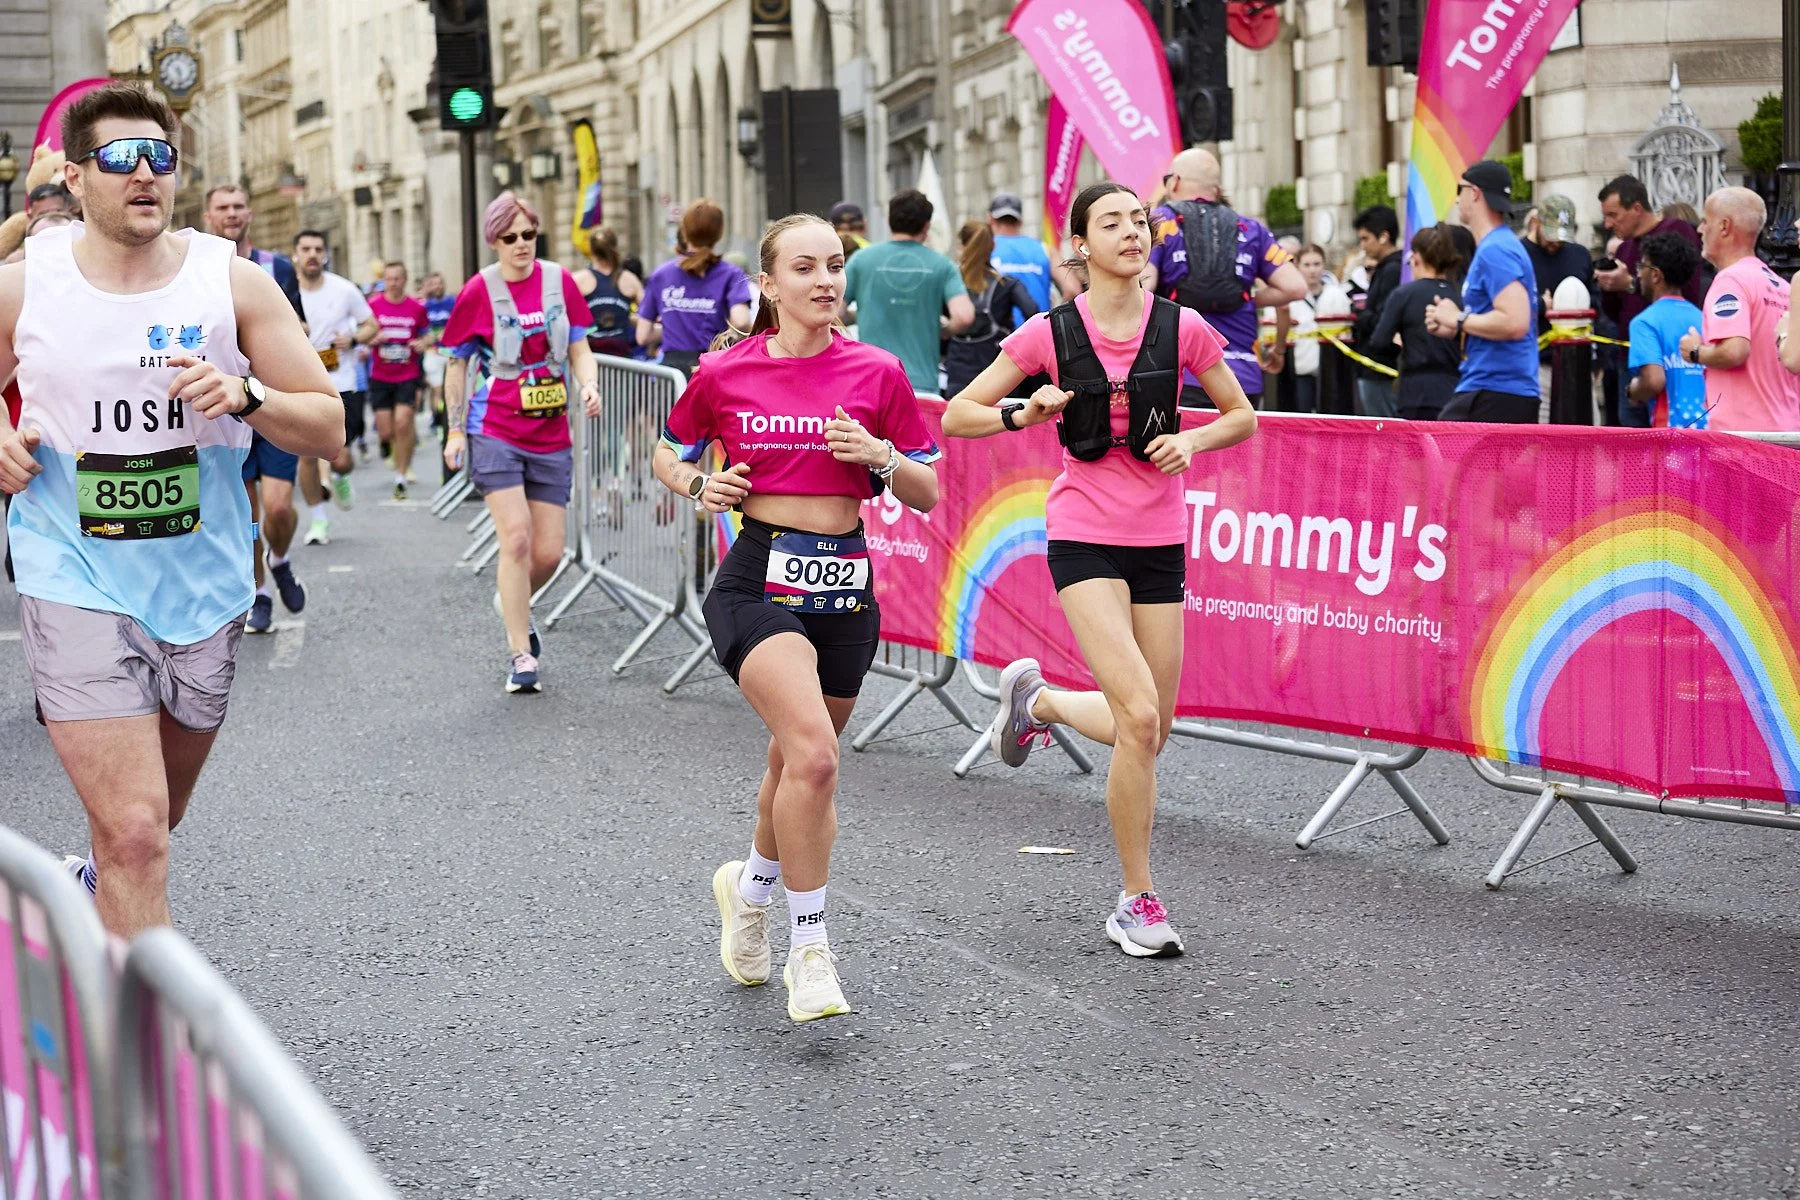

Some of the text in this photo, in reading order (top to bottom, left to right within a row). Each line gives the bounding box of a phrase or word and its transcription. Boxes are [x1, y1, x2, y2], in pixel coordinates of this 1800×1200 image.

[92, 398, 184, 433] JOSH
[739, 442, 751, 450] The
[752, 442, 793, 451] pregnancy
[794, 442, 810, 450] and
[124, 459, 154, 469] JOSH
[95, 474, 183, 510] 8505
[816, 541, 838, 551] ELLI
[1185, 489, 1448, 596] Tommy's
[784, 557, 856, 587] 9082
[1205, 596, 1283, 626] pregnancy
[1286, 603, 1319, 626] and
[1323, 603, 1369, 636] baby
[1374, 609, 1442, 643] charity
